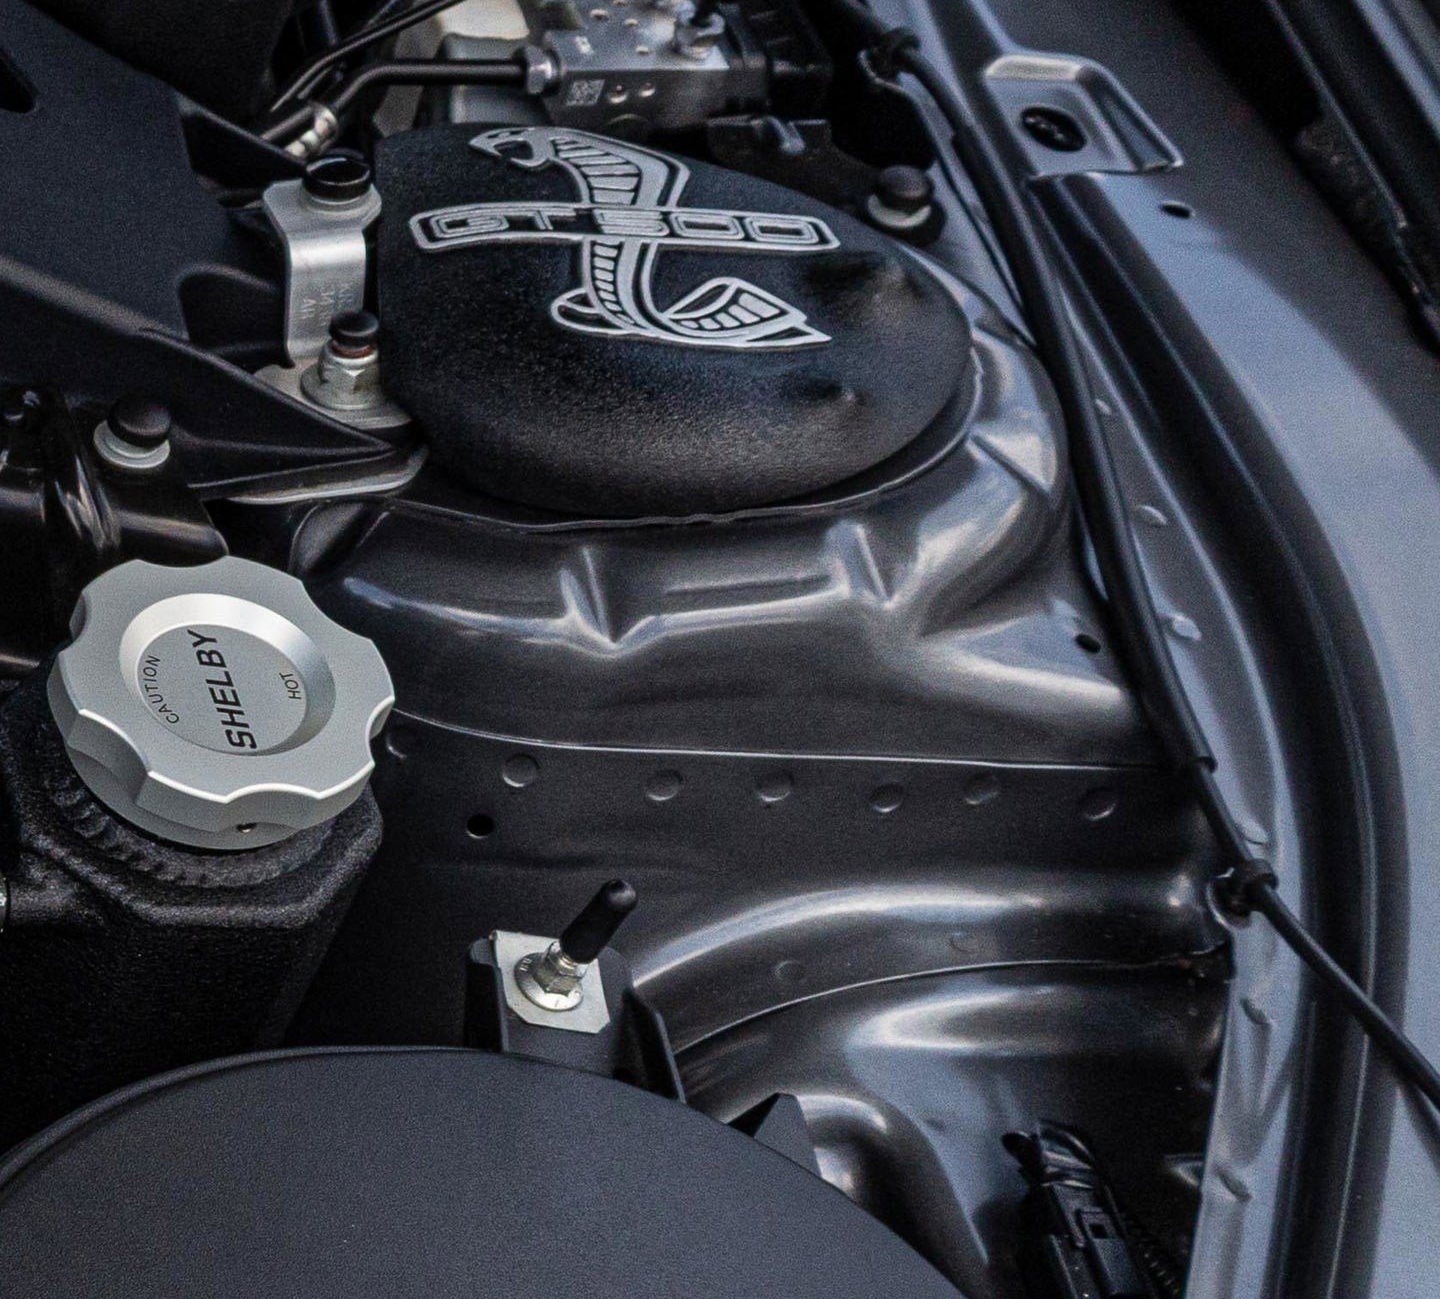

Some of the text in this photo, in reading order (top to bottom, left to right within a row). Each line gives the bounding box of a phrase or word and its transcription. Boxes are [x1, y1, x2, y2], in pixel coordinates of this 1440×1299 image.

[140, 654, 181, 726] CAUTION
[189, 629, 258, 750] SHELBY
[279, 670, 304, 701] HOT
